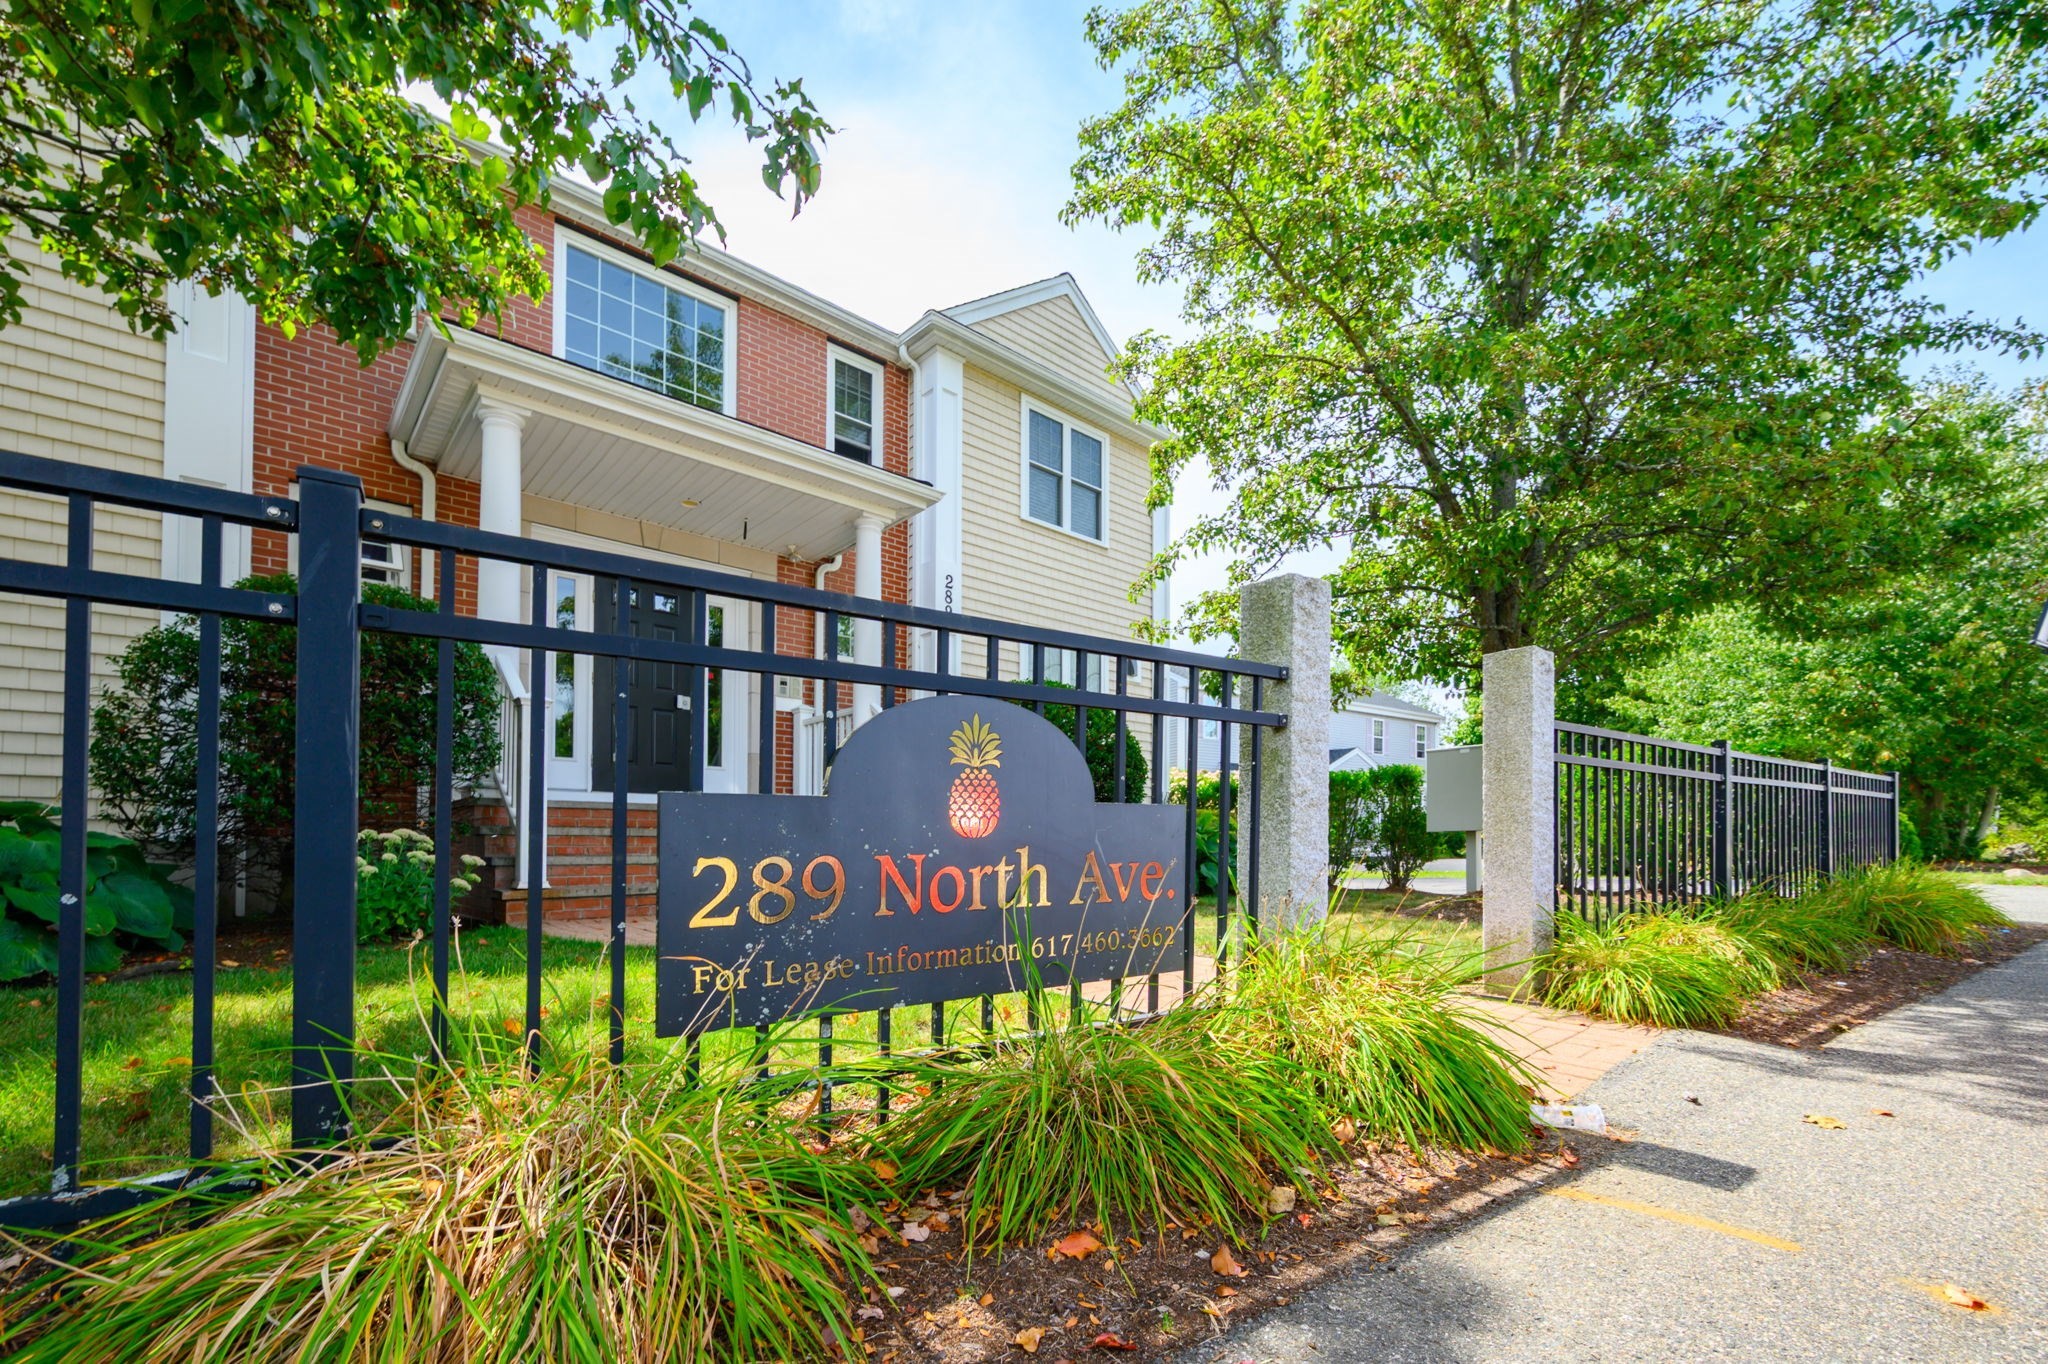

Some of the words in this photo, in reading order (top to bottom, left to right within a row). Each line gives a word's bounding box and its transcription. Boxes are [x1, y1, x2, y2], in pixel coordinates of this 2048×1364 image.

[688, 855, 846, 929] 289
[873, 845, 1052, 917] North
[1069, 849, 1175, 905] Ave.
[692, 965, 750, 994] For
[764, 957, 854, 987] Lease
[866, 939, 1021, 976] Information
